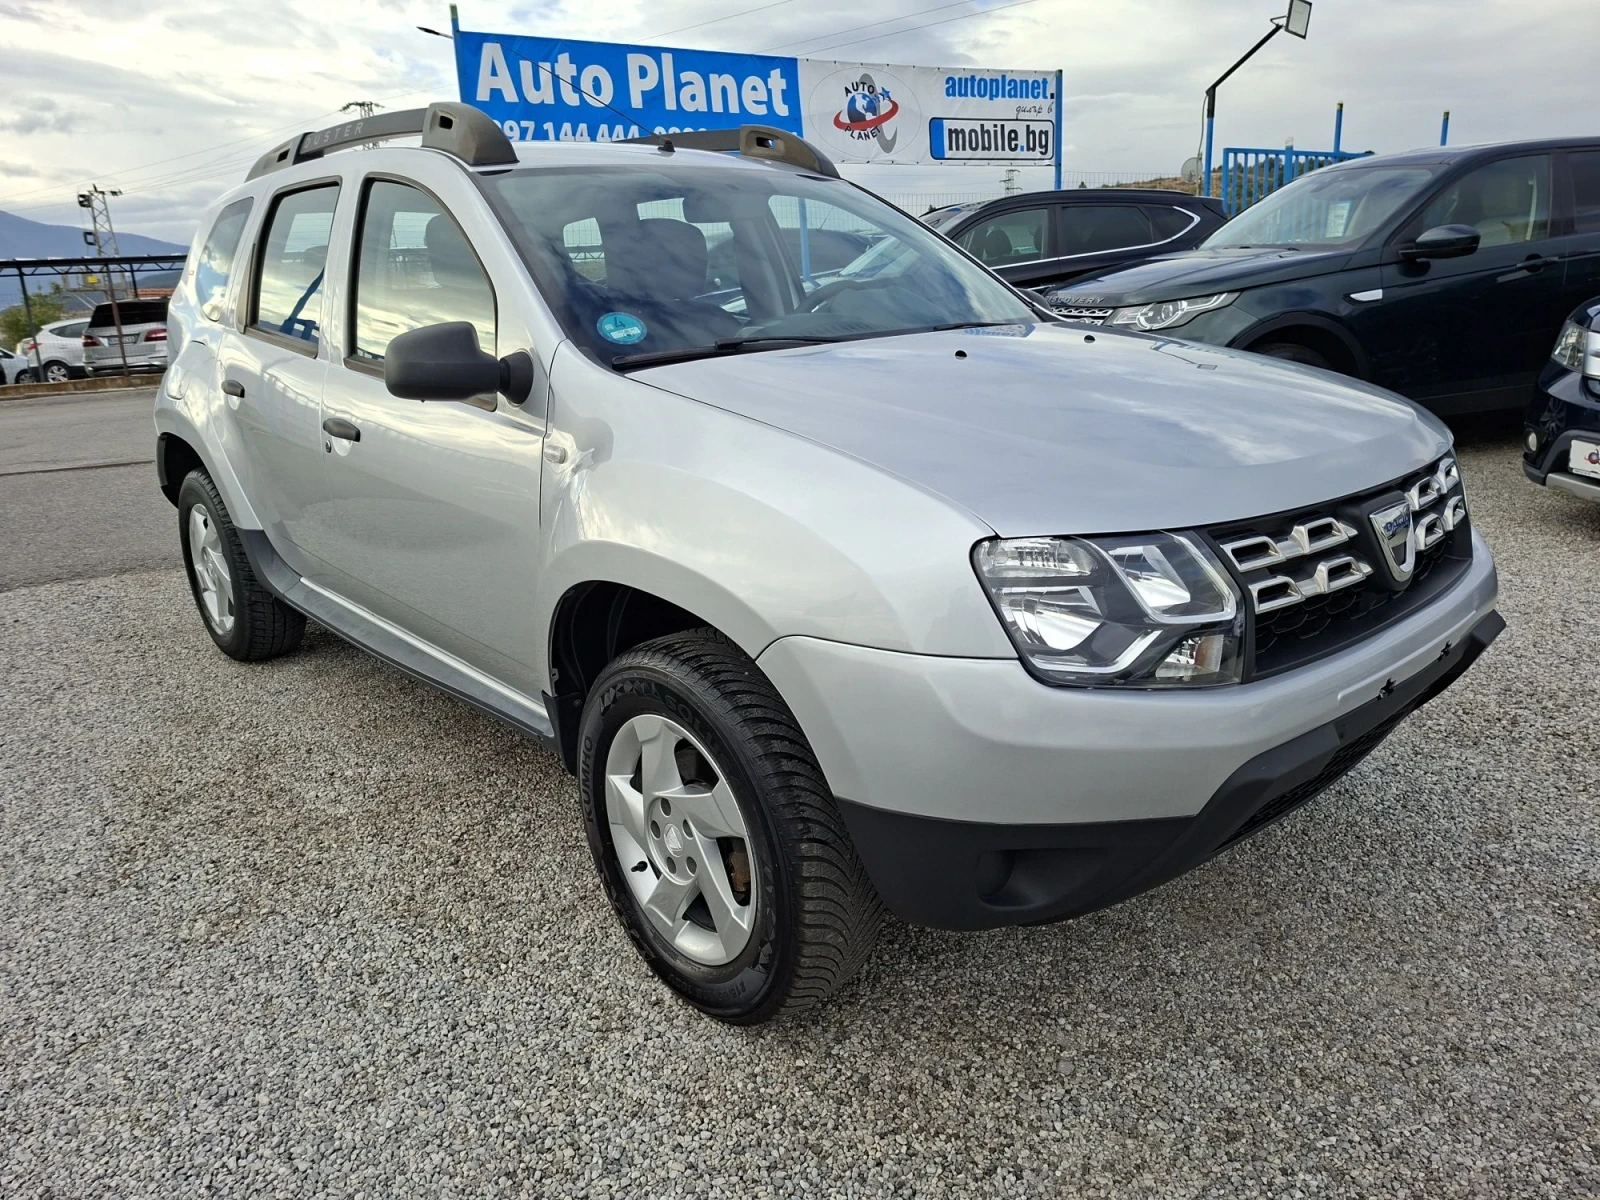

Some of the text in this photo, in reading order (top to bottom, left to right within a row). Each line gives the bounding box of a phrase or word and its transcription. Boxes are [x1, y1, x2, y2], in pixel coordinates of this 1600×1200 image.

[476, 43, 789, 117] Auto Planet
[844, 81, 875, 97] AUTO
[303, 121, 364, 149] DUSTER
[493, 119, 536, 141] 97
[543, 121, 591, 142] 144
[844, 125, 881, 141] PLANET
[947, 123, 1049, 155] mobile.bg
[581, 735, 594, 823] KUMHO
